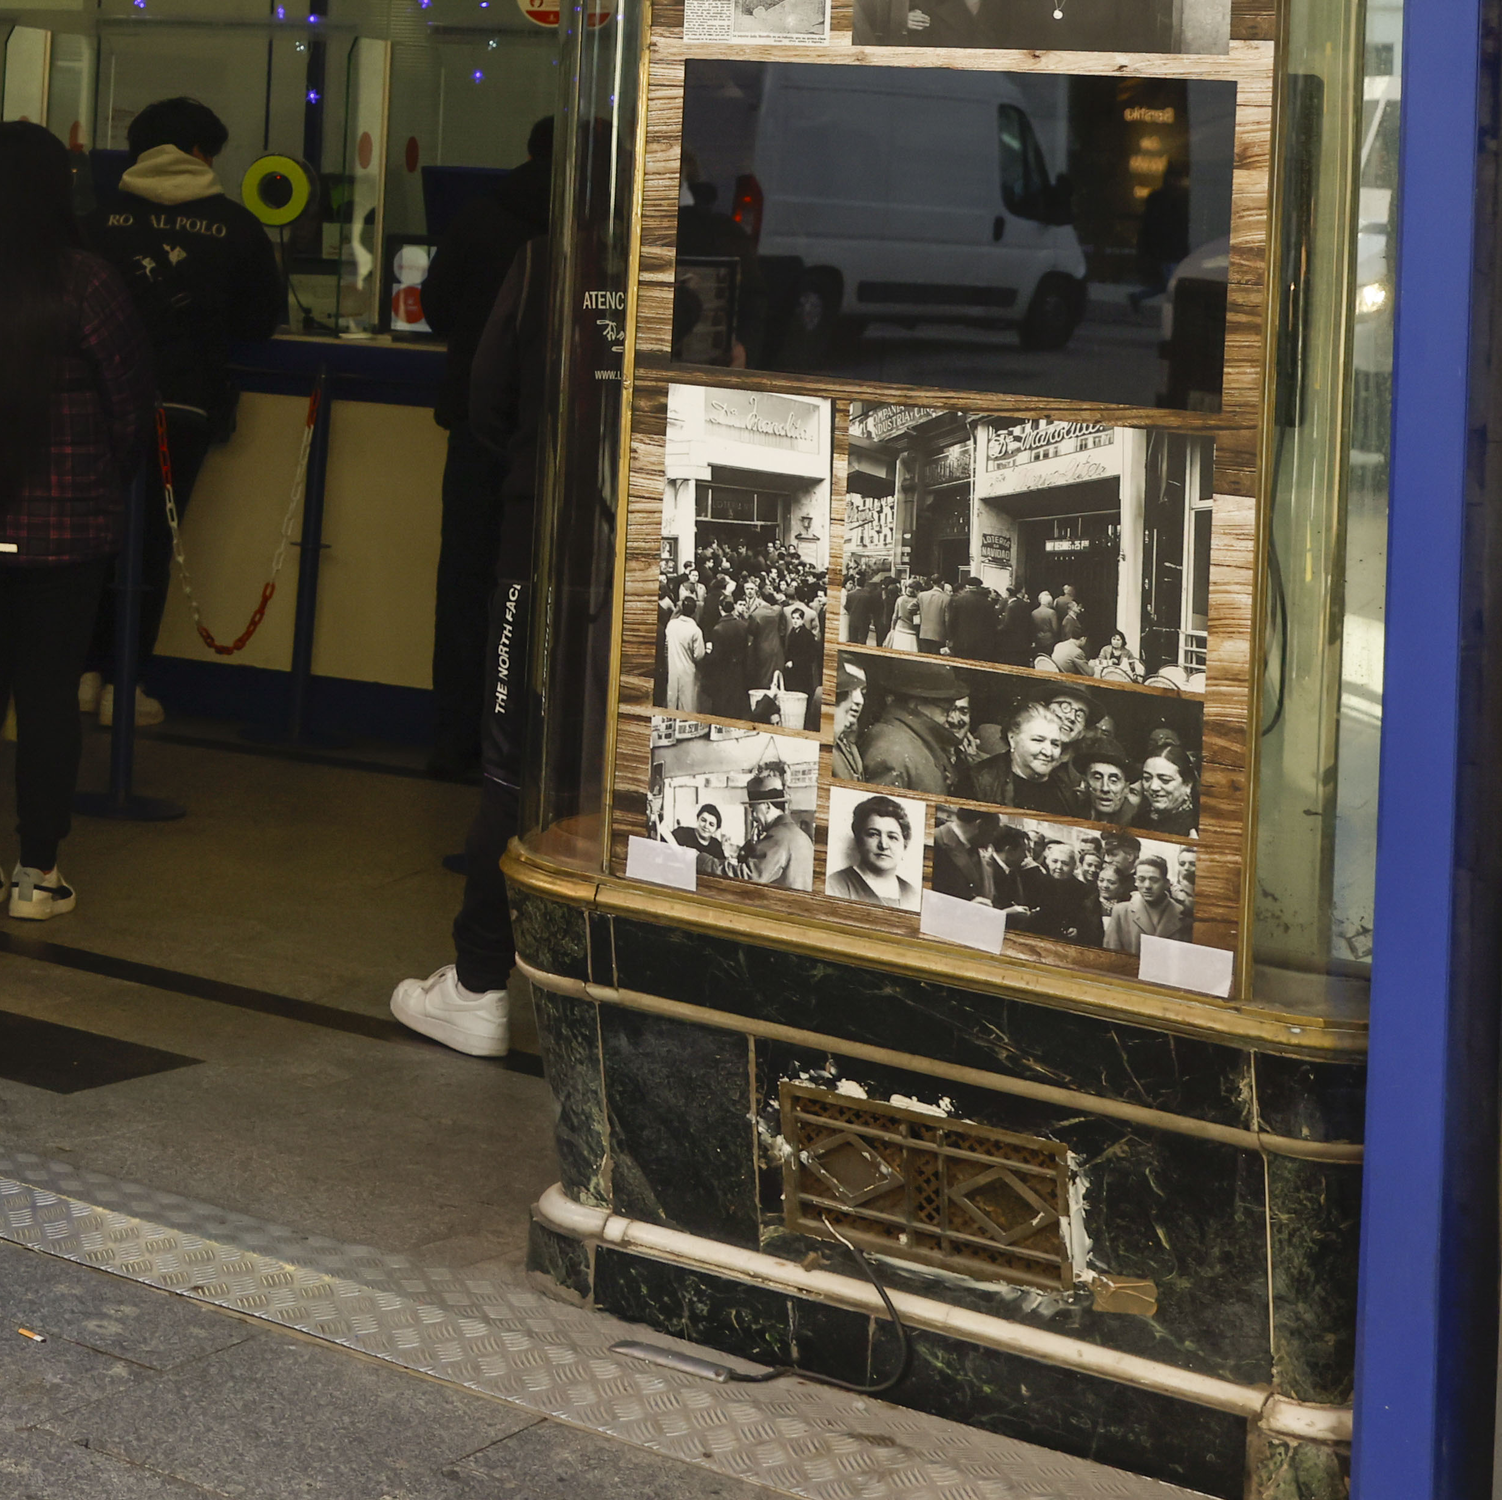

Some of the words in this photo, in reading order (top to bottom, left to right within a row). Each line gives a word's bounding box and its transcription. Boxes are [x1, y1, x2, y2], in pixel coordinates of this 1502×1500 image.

[176, 216, 226, 238] POLO
[982, 535, 1011, 547] LOTERIA
[982, 547, 1010, 560] NAVIDAD
[498, 623, 513, 680] NORTH
[495, 682, 508, 714] THE
